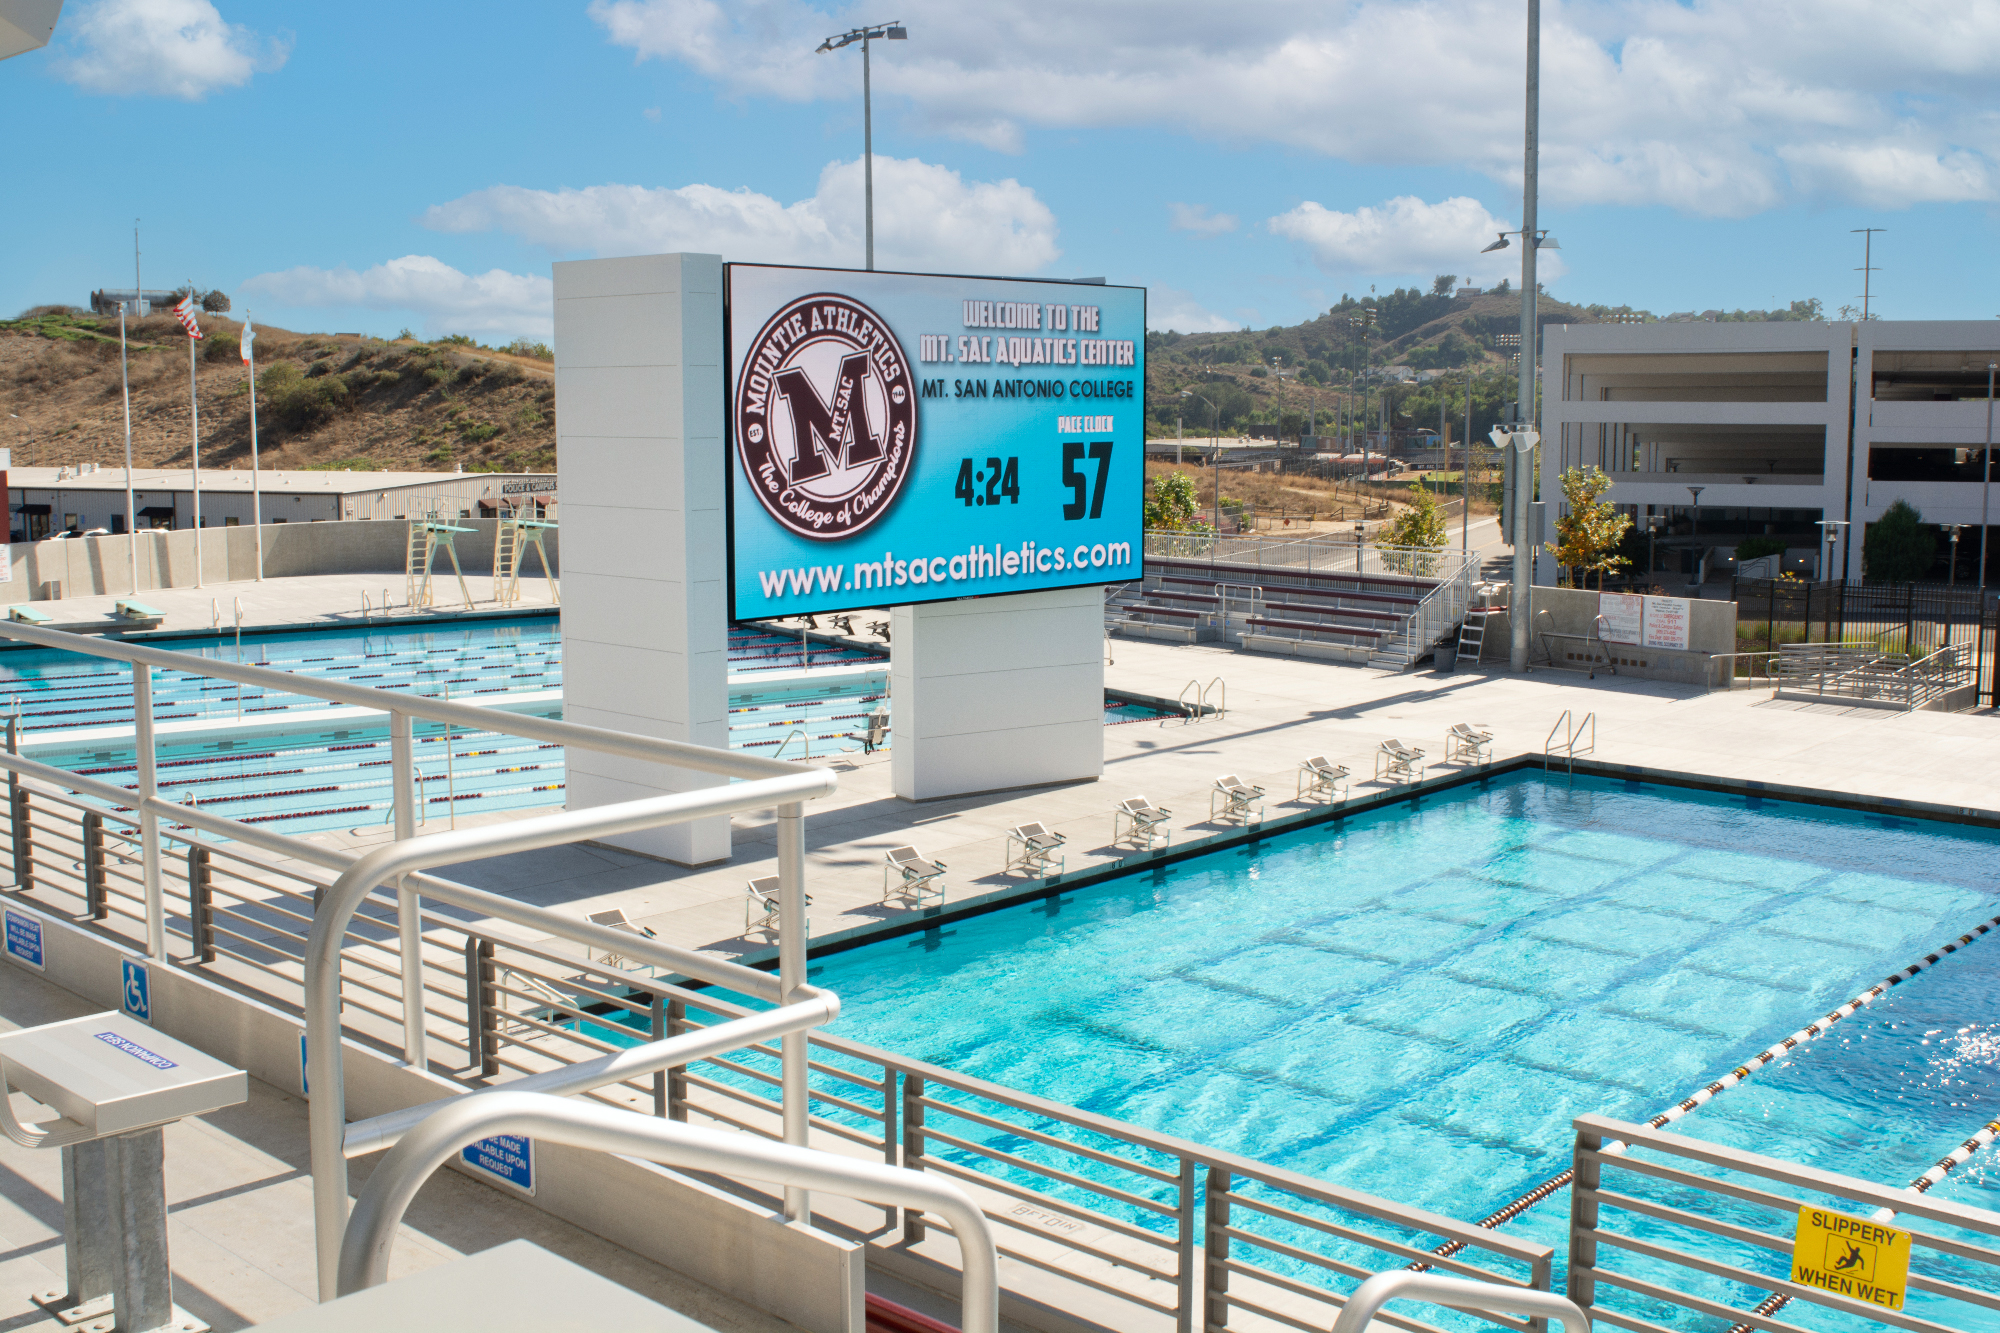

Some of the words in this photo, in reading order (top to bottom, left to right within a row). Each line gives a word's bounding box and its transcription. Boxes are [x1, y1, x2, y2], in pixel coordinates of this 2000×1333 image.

[963, 300, 1041, 330] WELCOME
[1045, 304, 1067, 330] TO
[1071, 305, 1099, 331] THE
[746, 313, 808, 416] MOUNTIE
[811, 306, 901, 382] ATHLETICS
[920, 334, 954, 362] MT.
[958, 335, 991, 363] SAC
[995, 336, 1077, 367] AQUATICS
[1080, 339, 1135, 366] CENTER
[922, 379, 949, 398] MT.
[954, 379, 987, 398] SAN
[992, 379, 1065, 398] ANTONIO
[1069, 380, 1133, 398] COLLEGE
[1058, 416, 1082, 434] PACE
[1084, 415, 1114, 433] CLOCK
[504, 484, 525, 493] POLICE
[532, 482, 555, 491] CAMPUS
[759, 451, 780, 493] The
[780, 489, 834, 529] College
[836, 501, 852, 526] of
[853, 420, 906, 515] Champions
[955, 456, 1020, 507] 4:24
[1062, 441, 1114, 521] 57
[759, 541, 1131, 598] www.mtsacathletics.com
[500, 1137, 522, 1155] MADE
[505, 1152, 527, 1170] UPON
[479, 1154, 514, 1177] REQUEST
[1811, 1211, 1897, 1246] SLIPPERY
[1798, 1265, 1853, 1295] WHEN
[1856, 1282, 1899, 1307] WET
